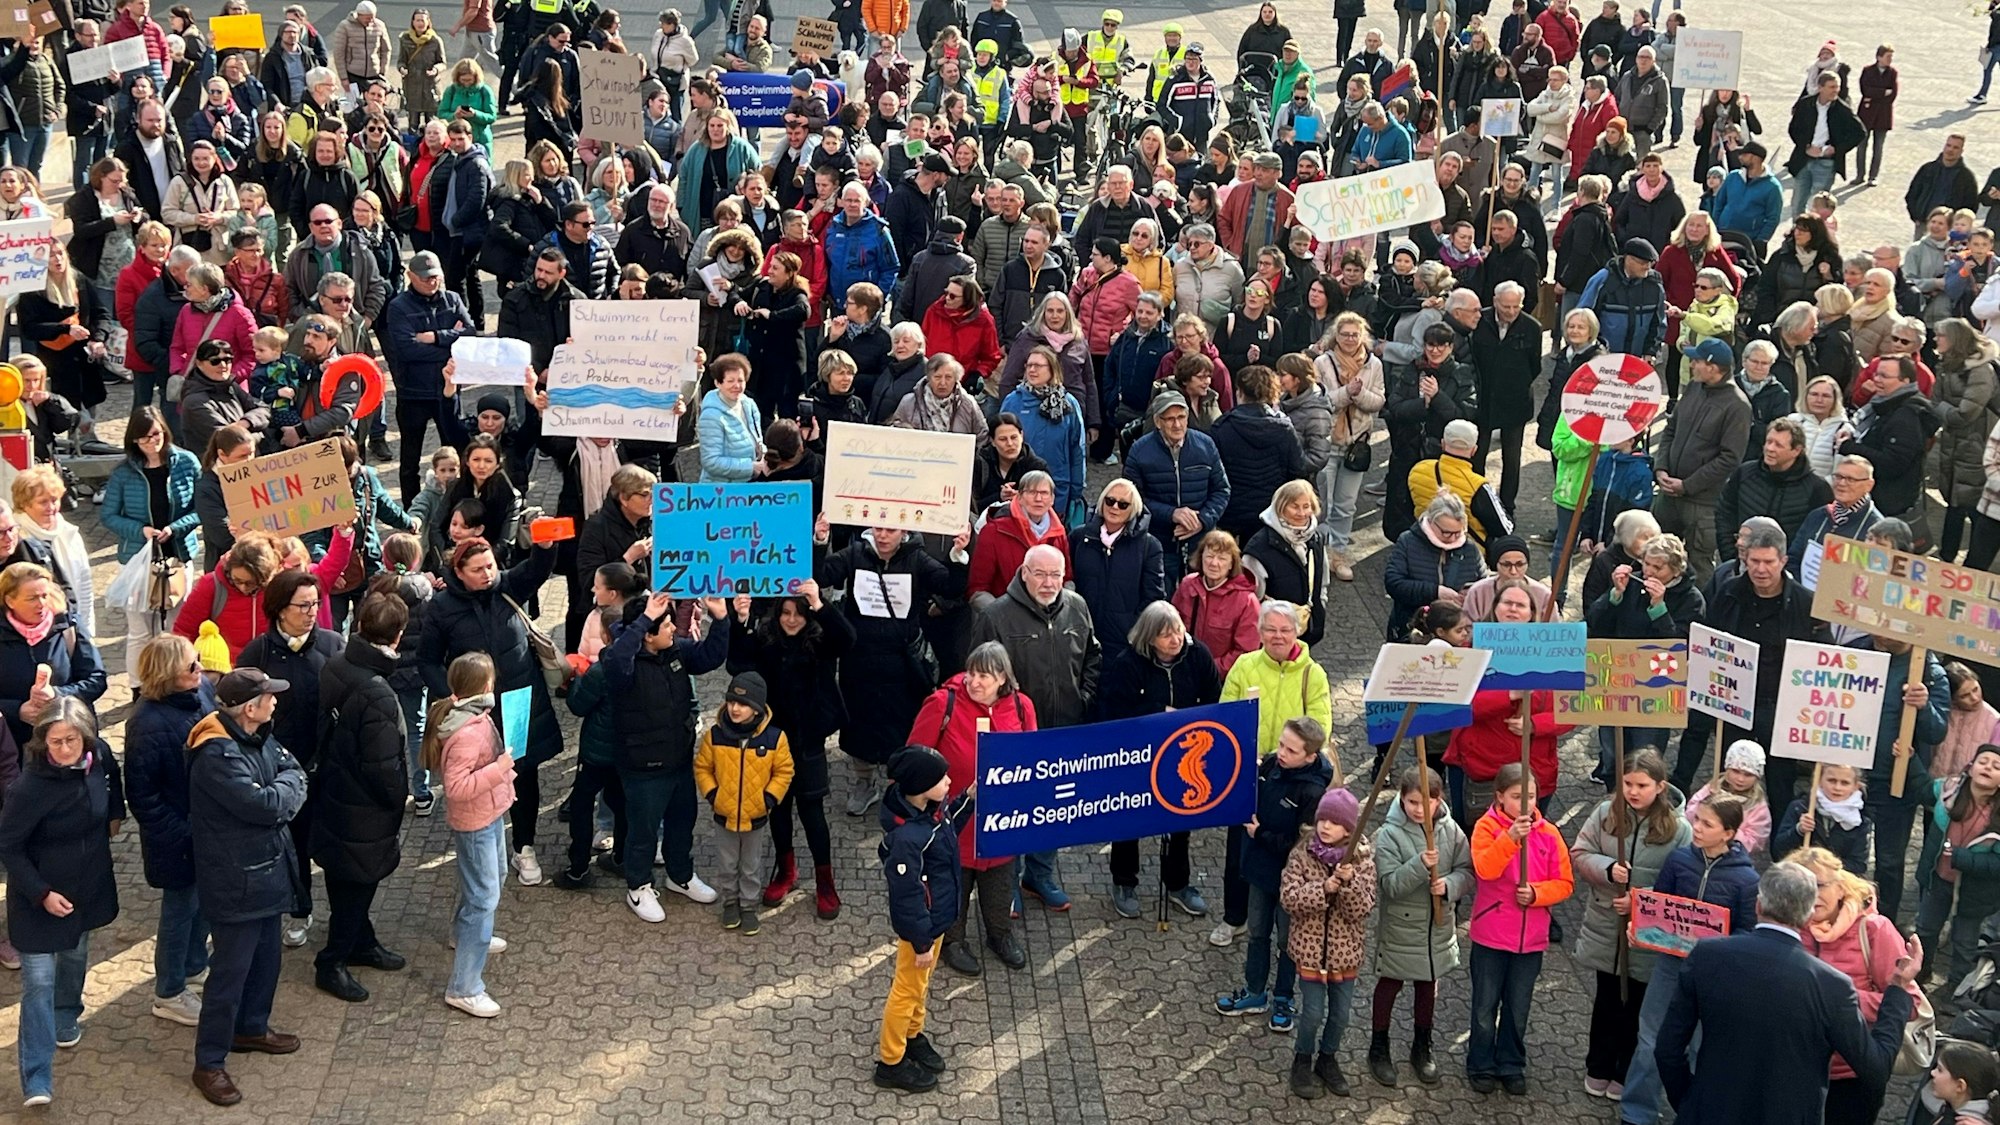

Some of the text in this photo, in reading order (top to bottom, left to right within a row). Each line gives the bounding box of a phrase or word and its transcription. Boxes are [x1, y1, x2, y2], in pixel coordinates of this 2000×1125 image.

[796, 27, 835, 43] SCHWIMMEN
[815, 22, 833, 32] WILL
[799, 39, 829, 50] LERNEN
[741, 84, 792, 96] Schwimmba
[589, 105, 639, 130] BUNT
[1370, 174, 1394, 192] man
[1302, 182, 1429, 227] Schwimmen
[574, 304, 651, 323] Schwimmen
[594, 329, 679, 342] man nicht im
[553, 350, 577, 366] Ein
[582, 348, 648, 367] Schwimmbad
[560, 370, 581, 385] ein
[585, 367, 632, 385] Problem
[549, 406, 676, 433] Schwimmbad retten!
[221, 450, 309, 484] WIR WOLLEN
[250, 472, 339, 509] NEIN ZUR
[658, 486, 800, 514] Schwimmen
[706, 521, 763, 541] Lernt
[659, 540, 797, 565] man nicht
[1824, 540, 1928, 583] KINDER
[658, 564, 802, 596] Zuhause
[1851, 574, 1870, 600] &
[1480, 627, 1578, 643] KINDER WOLLEN
[1710, 636, 1735, 653] KEIN
[1545, 646, 1586, 658] LERNEN
[1691, 643, 1754, 671] SCHWIMMBAD
[1817, 651, 1858, 670] DAS
[1586, 667, 1636, 689] ollen
[1709, 671, 1737, 691] KEIN
[1791, 669, 1884, 694] SCHWIMM-
[1690, 690, 1752, 722] PFERDCHEN
[1809, 689, 1855, 710] BAD
[1796, 707, 1850, 731] SOLL
[1788, 727, 1871, 752] BLEIBEN!
[985, 743, 1153, 787] Kein Schwimmbad
[983, 789, 1153, 833] Kein Seepferdchen
[1640, 904, 1657, 916] das
